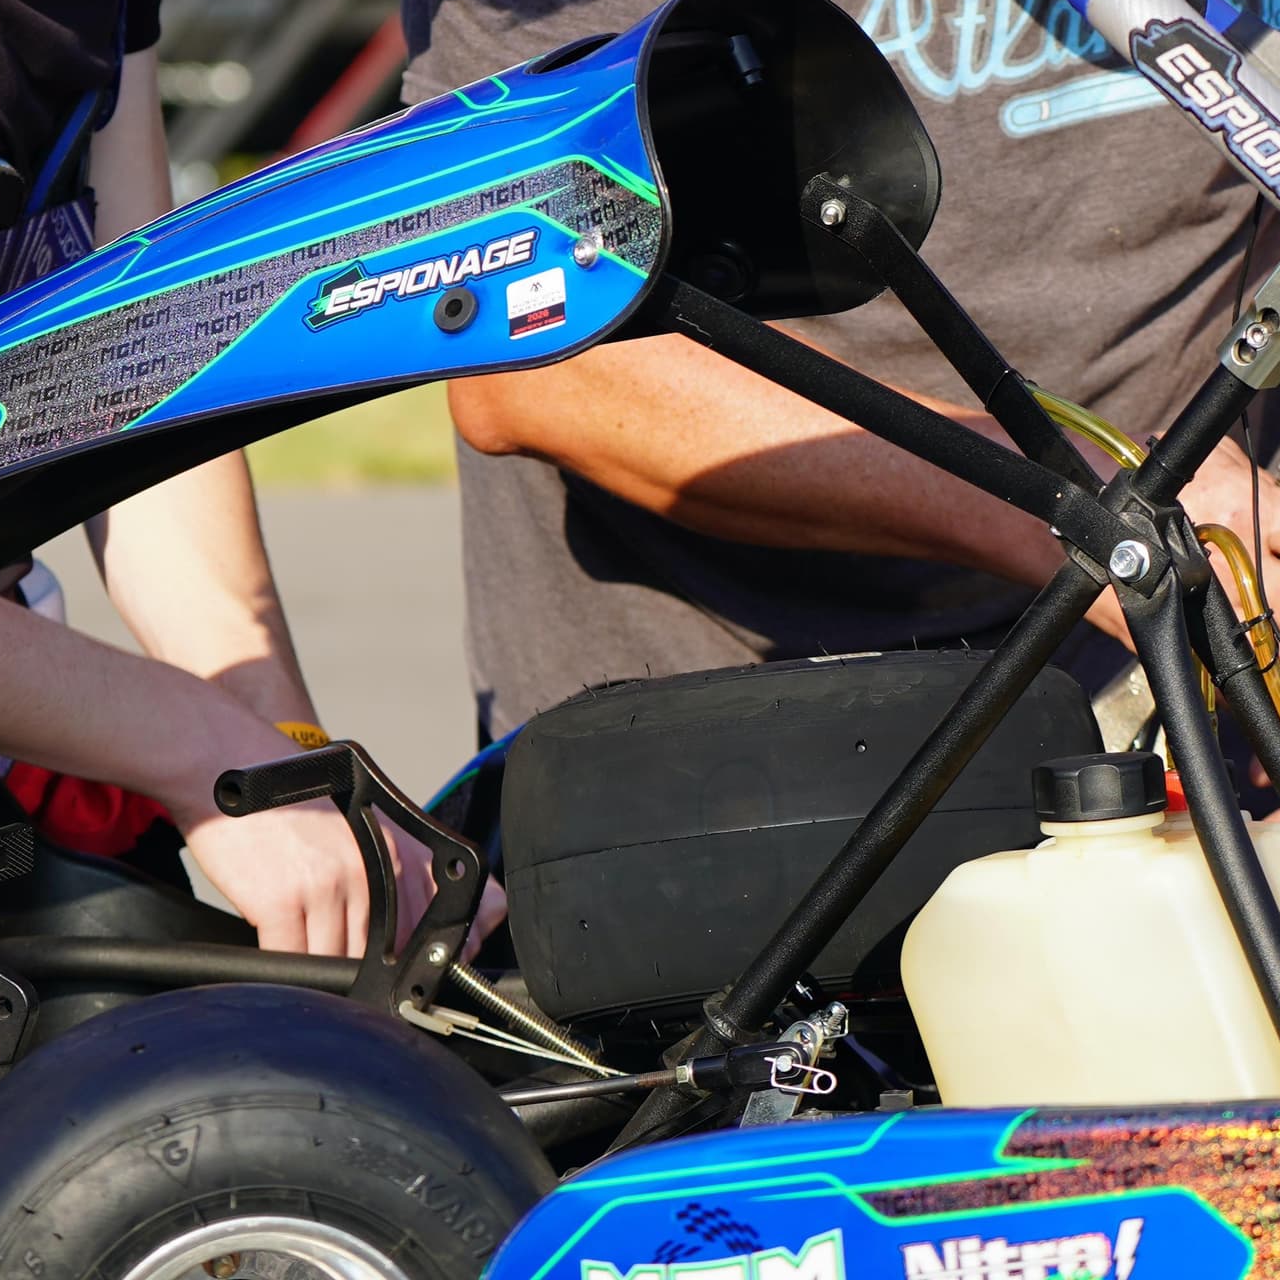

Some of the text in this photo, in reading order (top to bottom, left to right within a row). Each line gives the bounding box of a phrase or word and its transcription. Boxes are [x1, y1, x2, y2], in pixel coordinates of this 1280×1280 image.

[385, 209, 431, 238] MGM
[602, 218, 641, 247] MGM
[325, 231, 535, 316] ESPIONAGE
[220, 281, 264, 309] MGM
[126, 307, 170, 333] MGM
[196, 312, 241, 339] MGM
[36, 335, 79, 361] MGM
[100, 337, 145, 364] MGM
[9, 364, 54, 390] MGM
[121, 356, 166, 382] MGM
[28, 381, 71, 405] MGM
[94, 385, 140, 412] MGM
[20, 427, 64, 451] MGM
